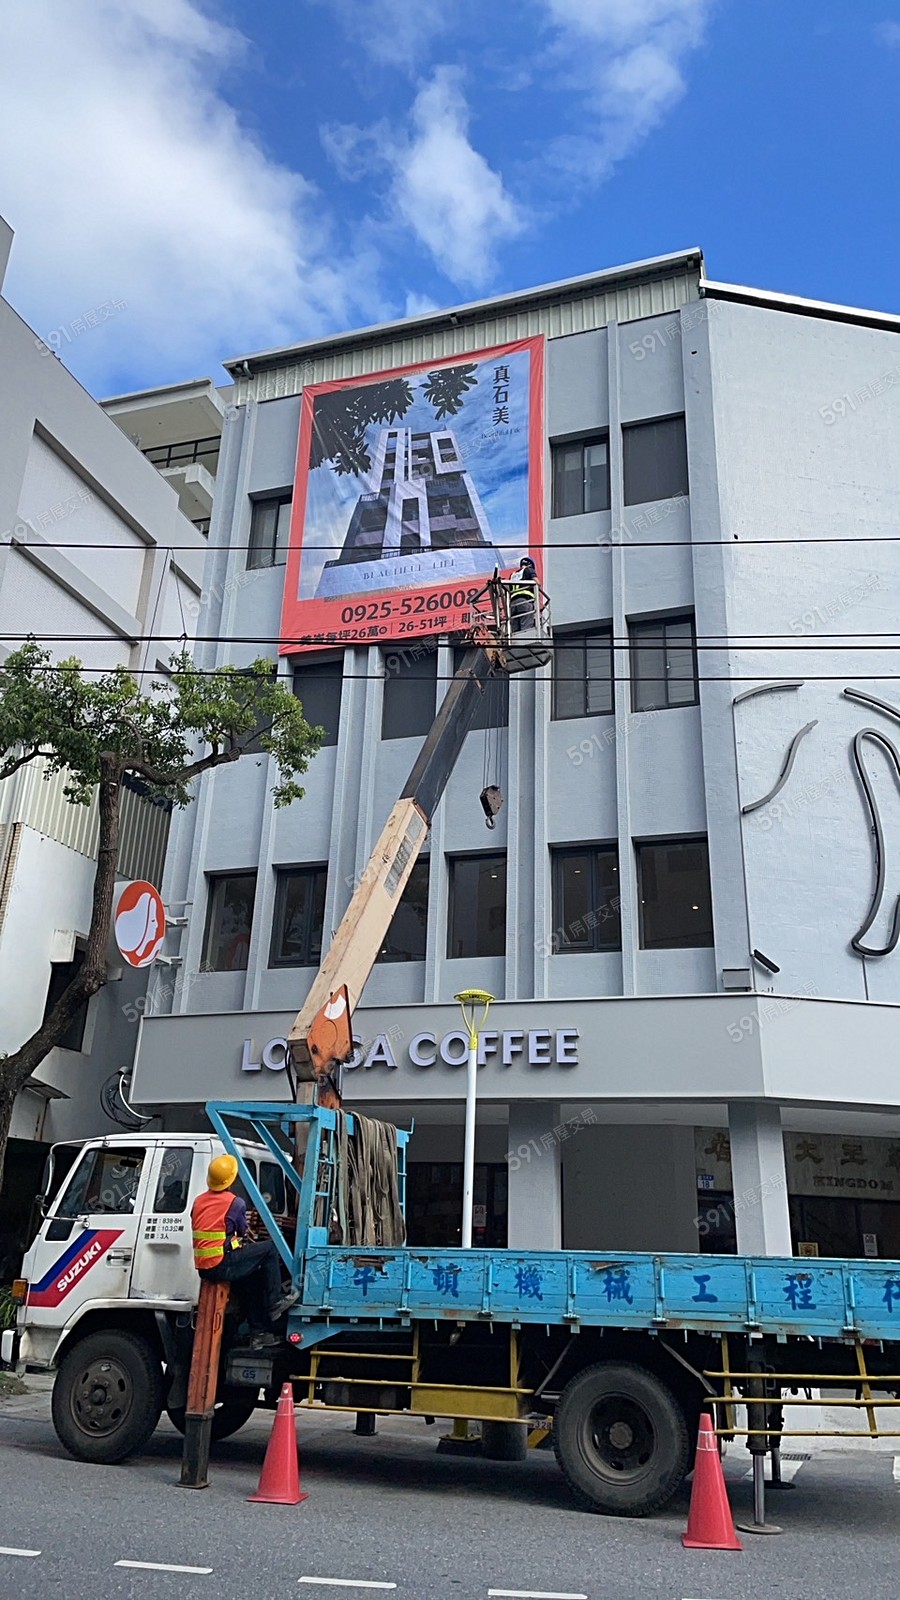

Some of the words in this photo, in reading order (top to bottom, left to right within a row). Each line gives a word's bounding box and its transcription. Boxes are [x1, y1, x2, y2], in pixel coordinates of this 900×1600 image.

[492, 365, 511, 427] 真石美
[341, 587, 479, 624] 0925-526008
[398, 614, 447, 633] 26-51坪
[241, 1033, 398, 1071] LOSA
[408, 1028, 580, 1068] COFFEE
[813, 1175, 894, 1191] KINGDOM
[56, 1241, 102, 1292] SUZUKI
[242, 1369, 257, 1379] GS
